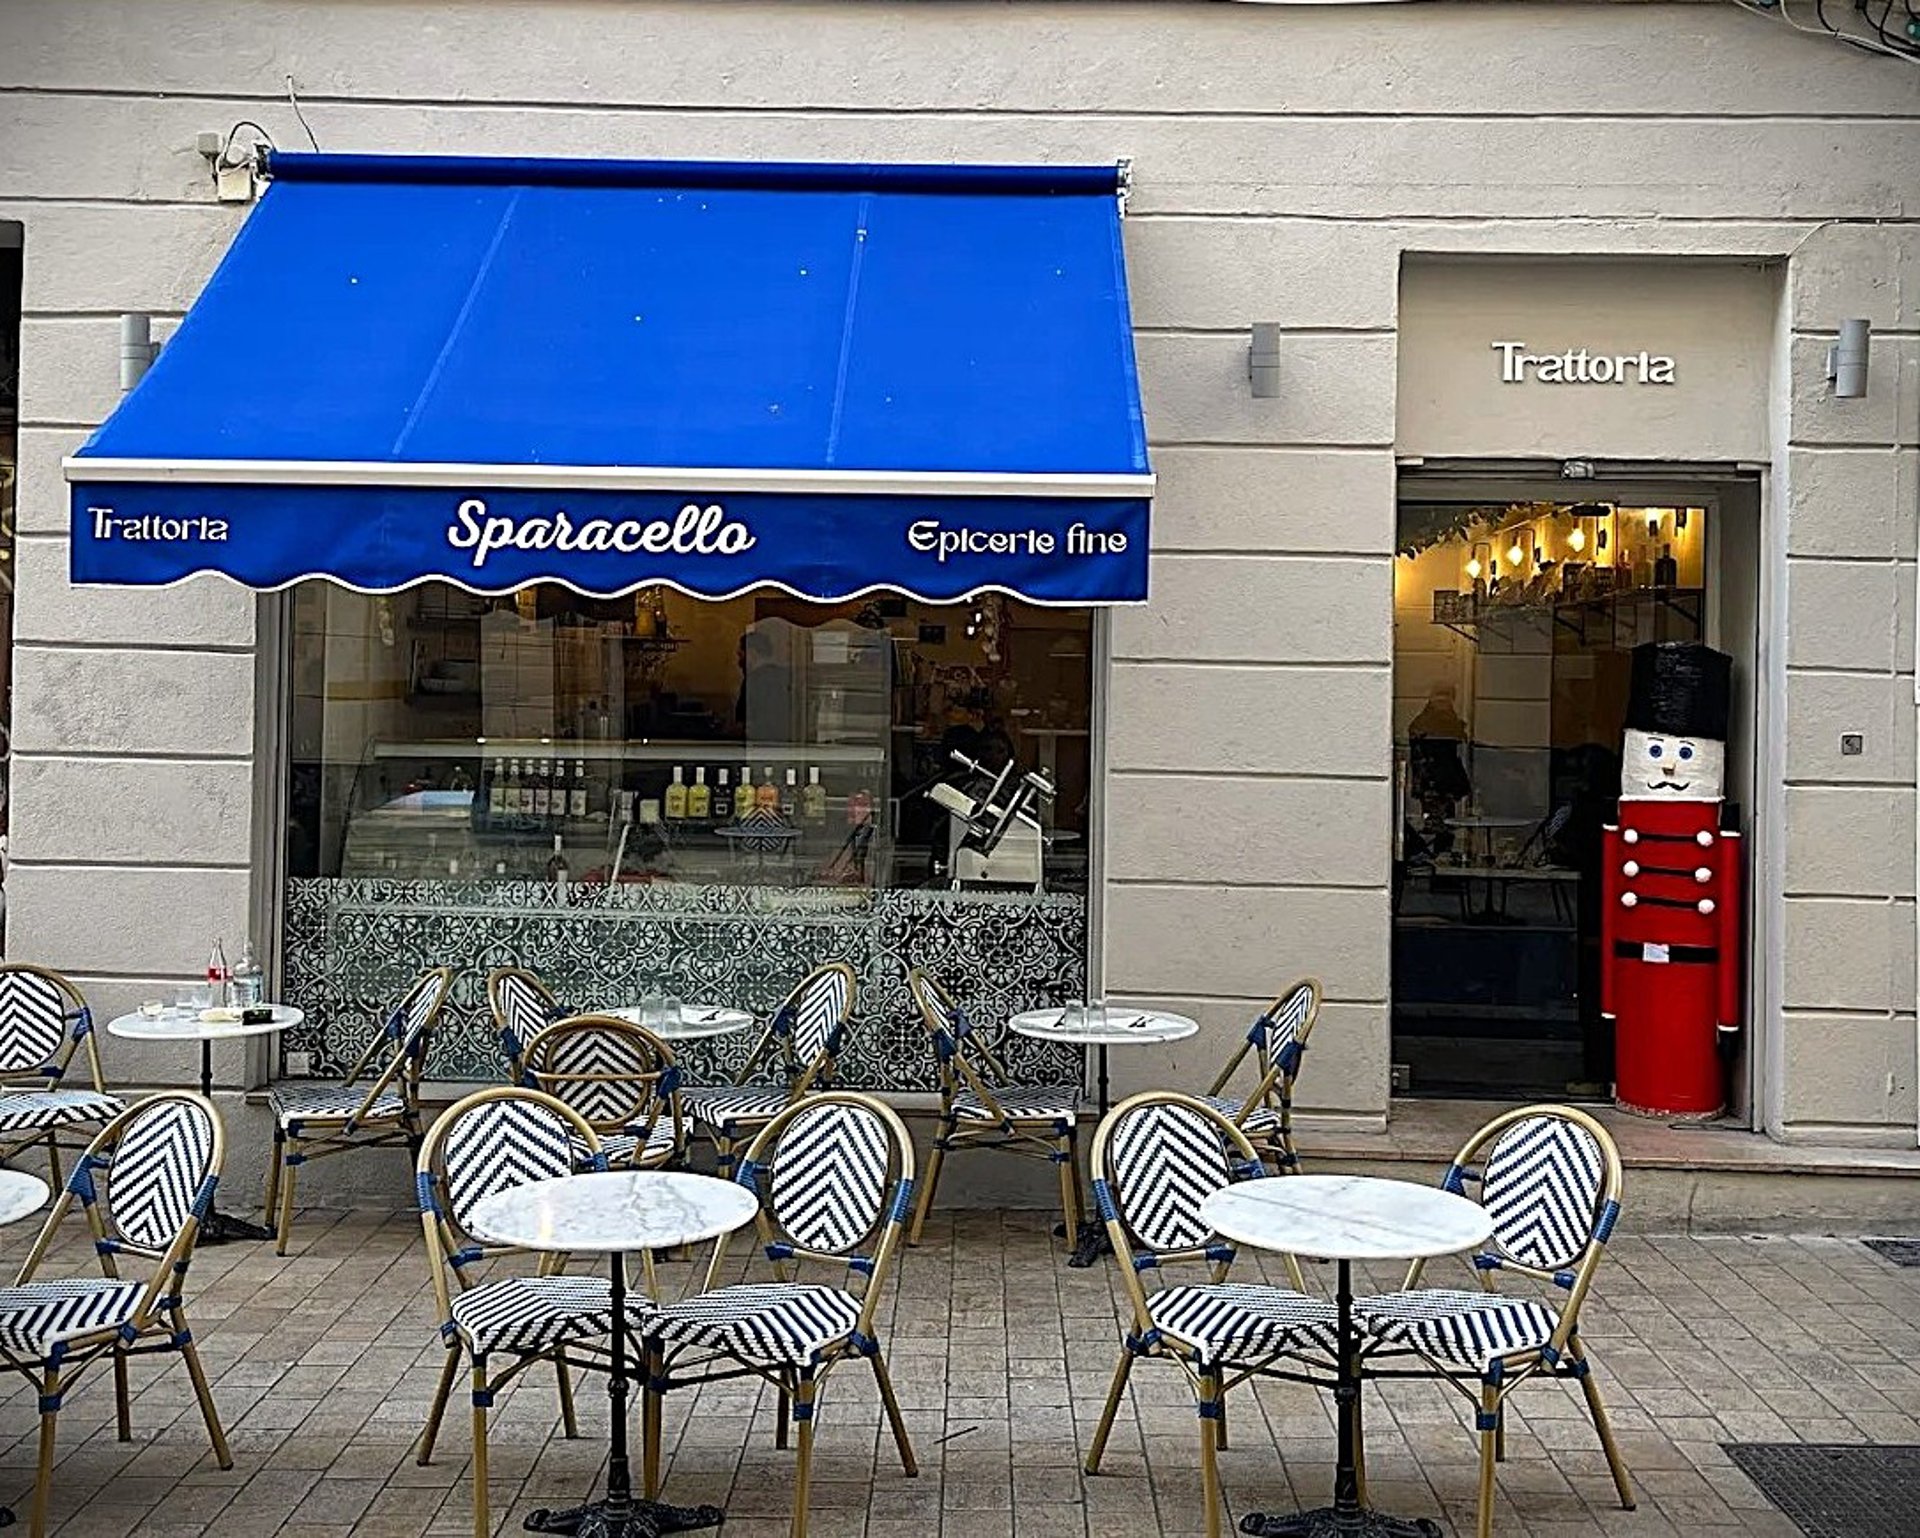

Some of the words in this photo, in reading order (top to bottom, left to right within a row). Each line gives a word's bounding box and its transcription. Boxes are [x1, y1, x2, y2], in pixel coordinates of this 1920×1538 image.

[1491, 341, 1676, 383] Trattoria
[87, 507, 229, 541] Trattoria
[447, 499, 757, 567] Sparacello
[908, 520, 1055, 562] Epicerie
[1067, 522, 1128, 554] fine
